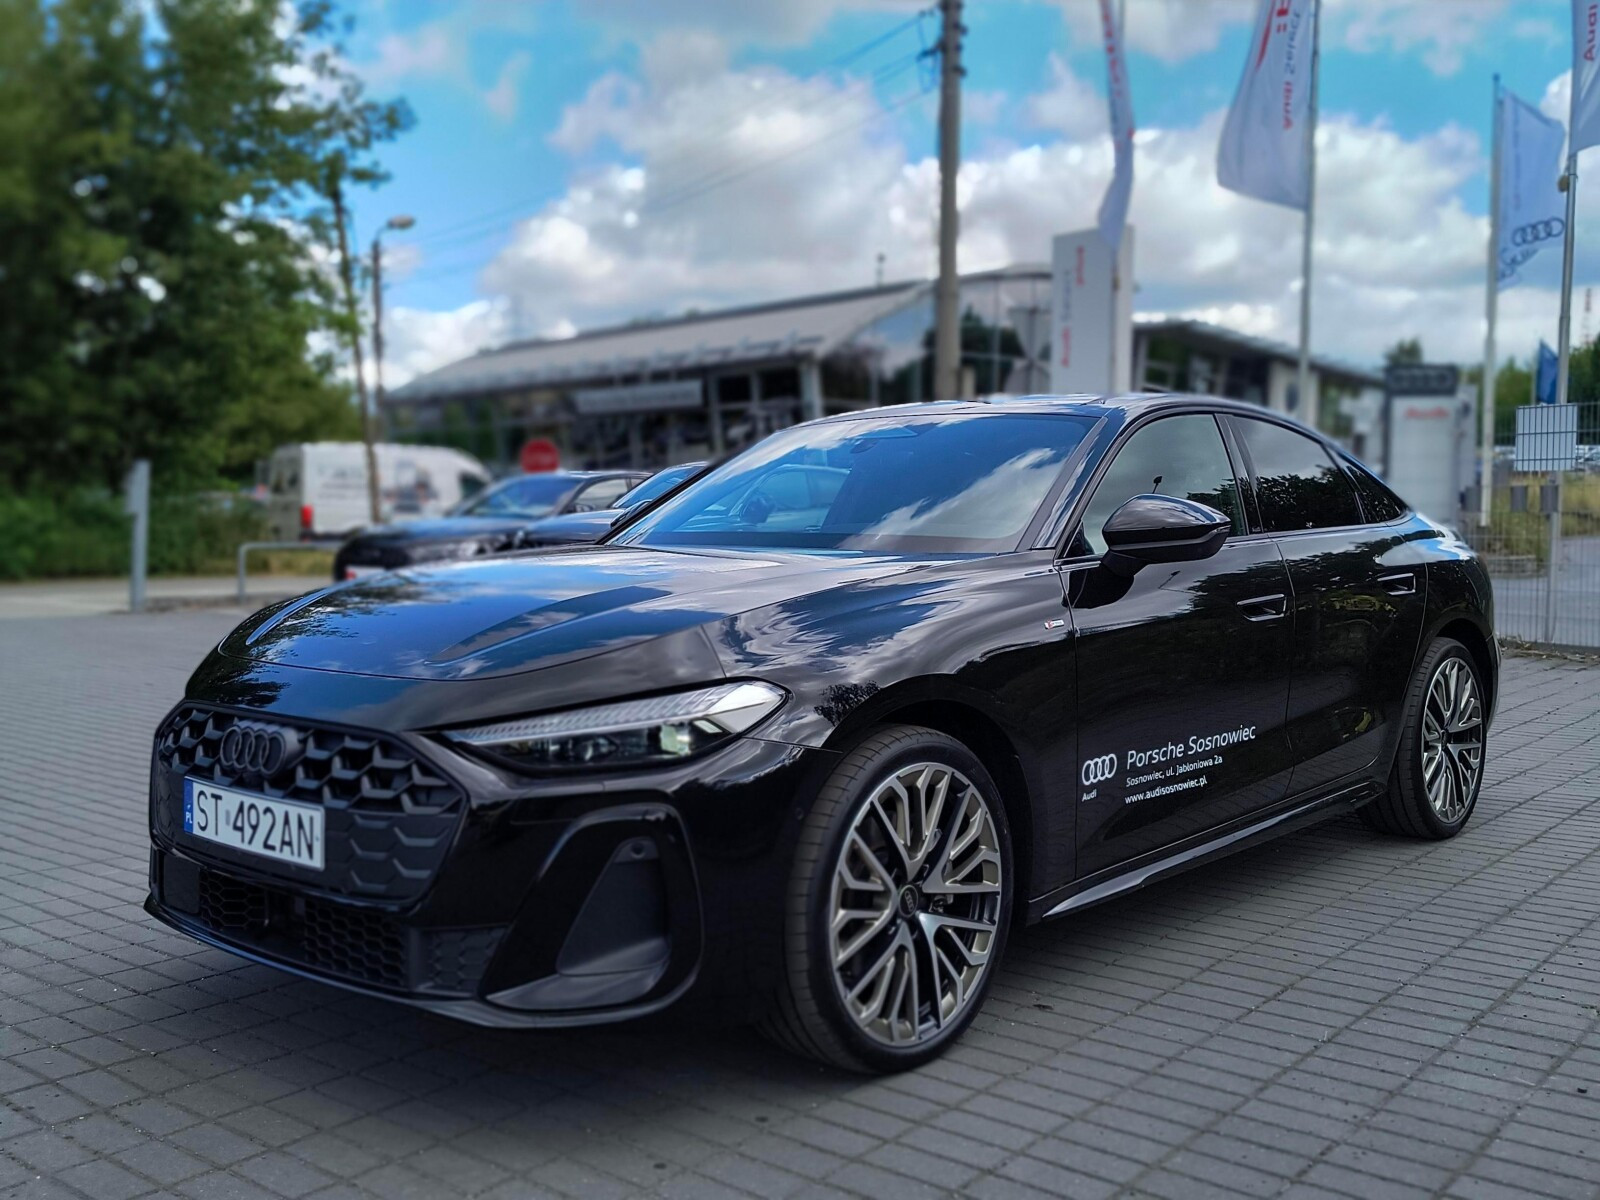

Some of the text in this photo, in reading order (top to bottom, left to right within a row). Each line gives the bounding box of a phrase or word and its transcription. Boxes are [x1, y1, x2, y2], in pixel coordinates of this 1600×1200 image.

[1584, 4, 1598, 62] Audi
[1127, 725, 1256, 769] Porsche Sosnowiec
[1126, 771, 1164, 787] Sosnowiec,
[1166, 767, 1175, 777] ul.
[1214, 755, 1223, 765] 2a
[1082, 789, 1097, 802] Audi
[1125, 775, 1207, 804] www.audisosnowiec.pl
[185, 811, 193, 824] PL
[197, 790, 313, 860] ST 492AN
